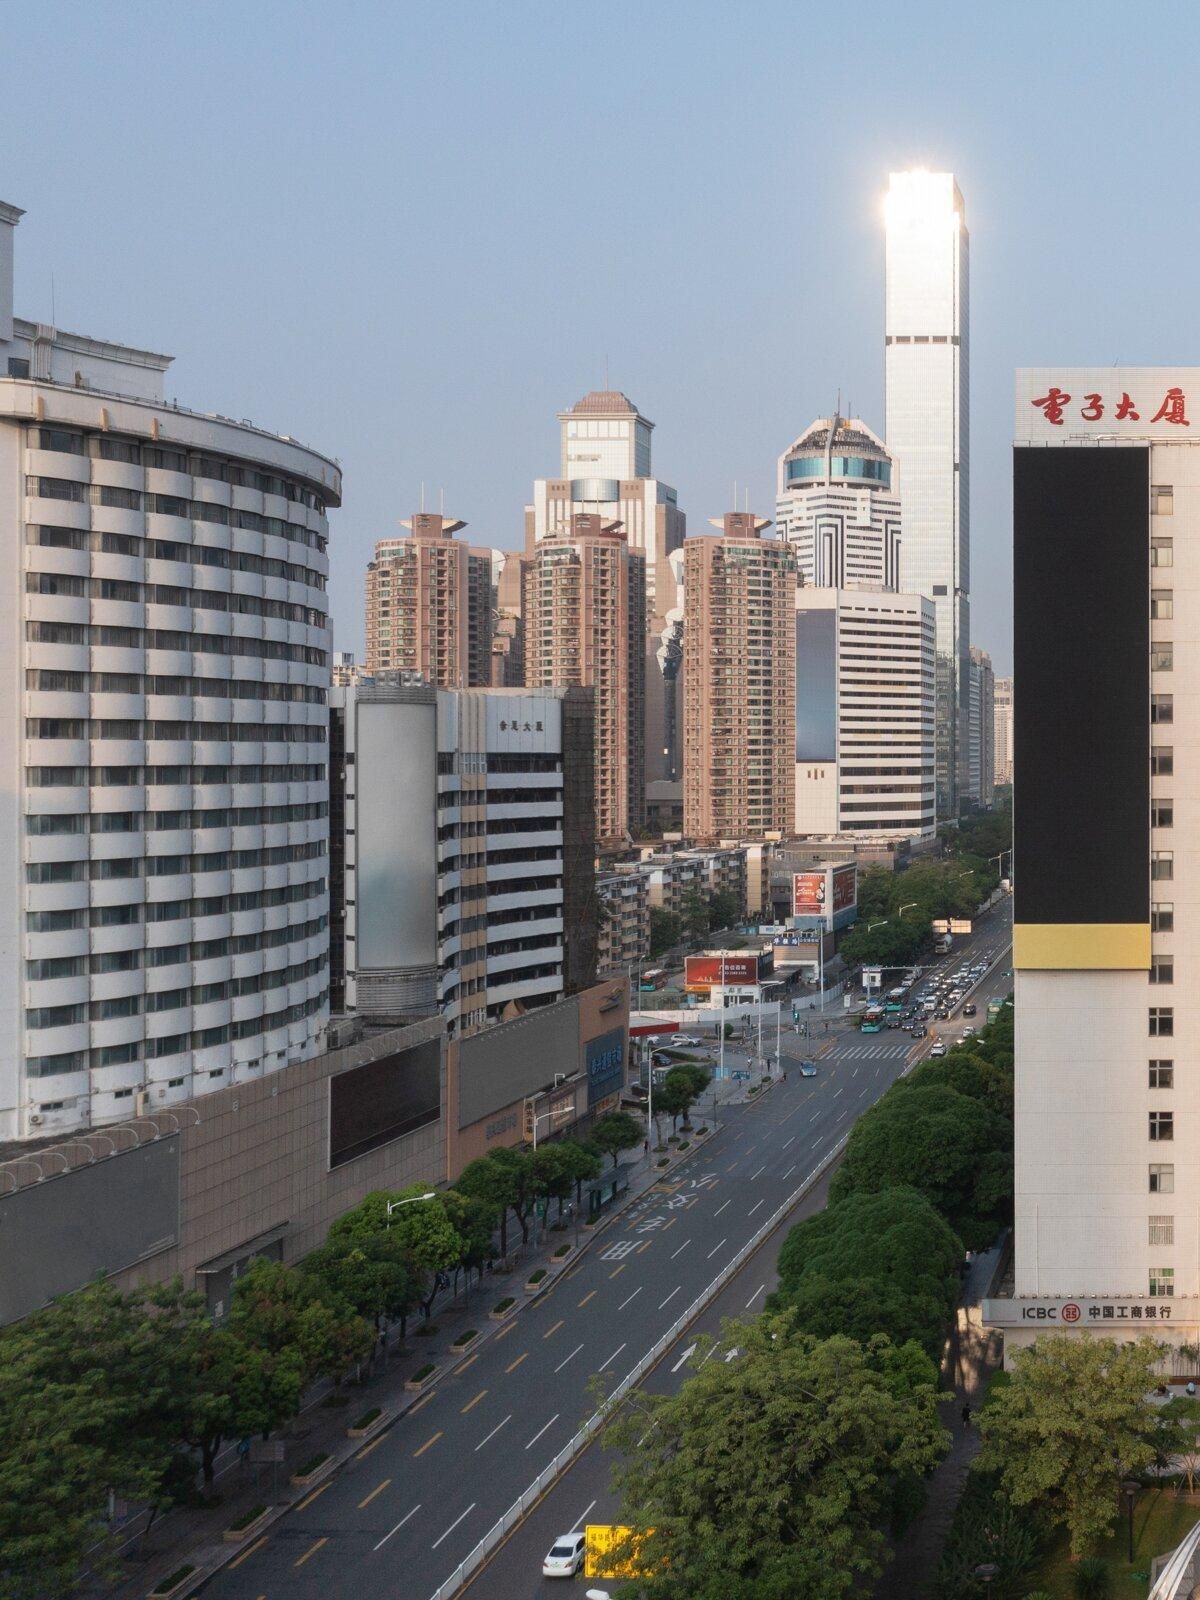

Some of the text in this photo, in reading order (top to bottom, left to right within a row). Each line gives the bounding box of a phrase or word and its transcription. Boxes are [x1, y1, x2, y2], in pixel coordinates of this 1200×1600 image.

[1022, 1305, 1172, 1319] ICBC 中国工商银行
